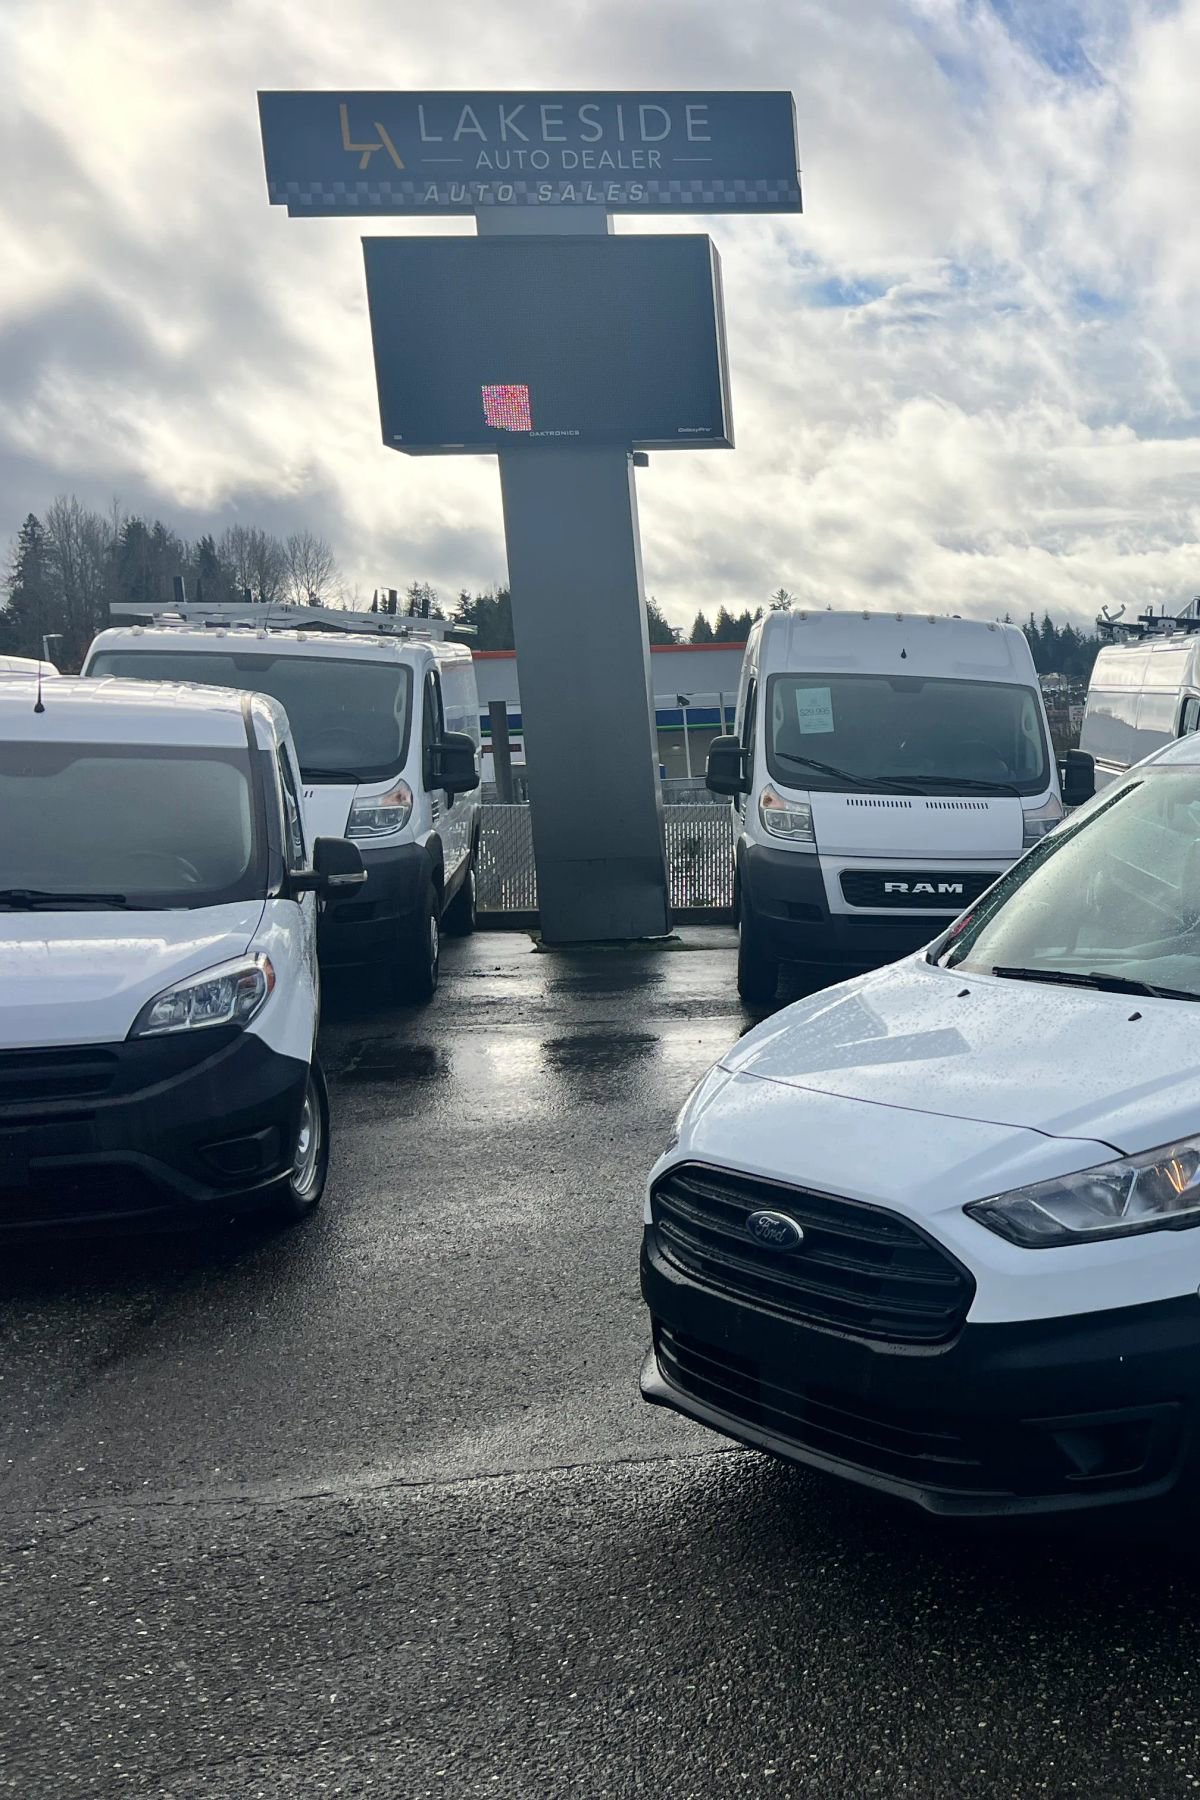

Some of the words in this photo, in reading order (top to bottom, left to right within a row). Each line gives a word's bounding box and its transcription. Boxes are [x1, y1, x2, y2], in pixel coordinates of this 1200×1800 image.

[418, 104, 712, 142] LAKESIDE
[475, 150, 550, 169] AUTO
[561, 150, 662, 169] DEALER
[424, 184, 513, 202] AUTO
[538, 184, 645, 201] SALES
[884, 882, 963, 893] RAM
[755, 1216, 788, 1242] Ford
